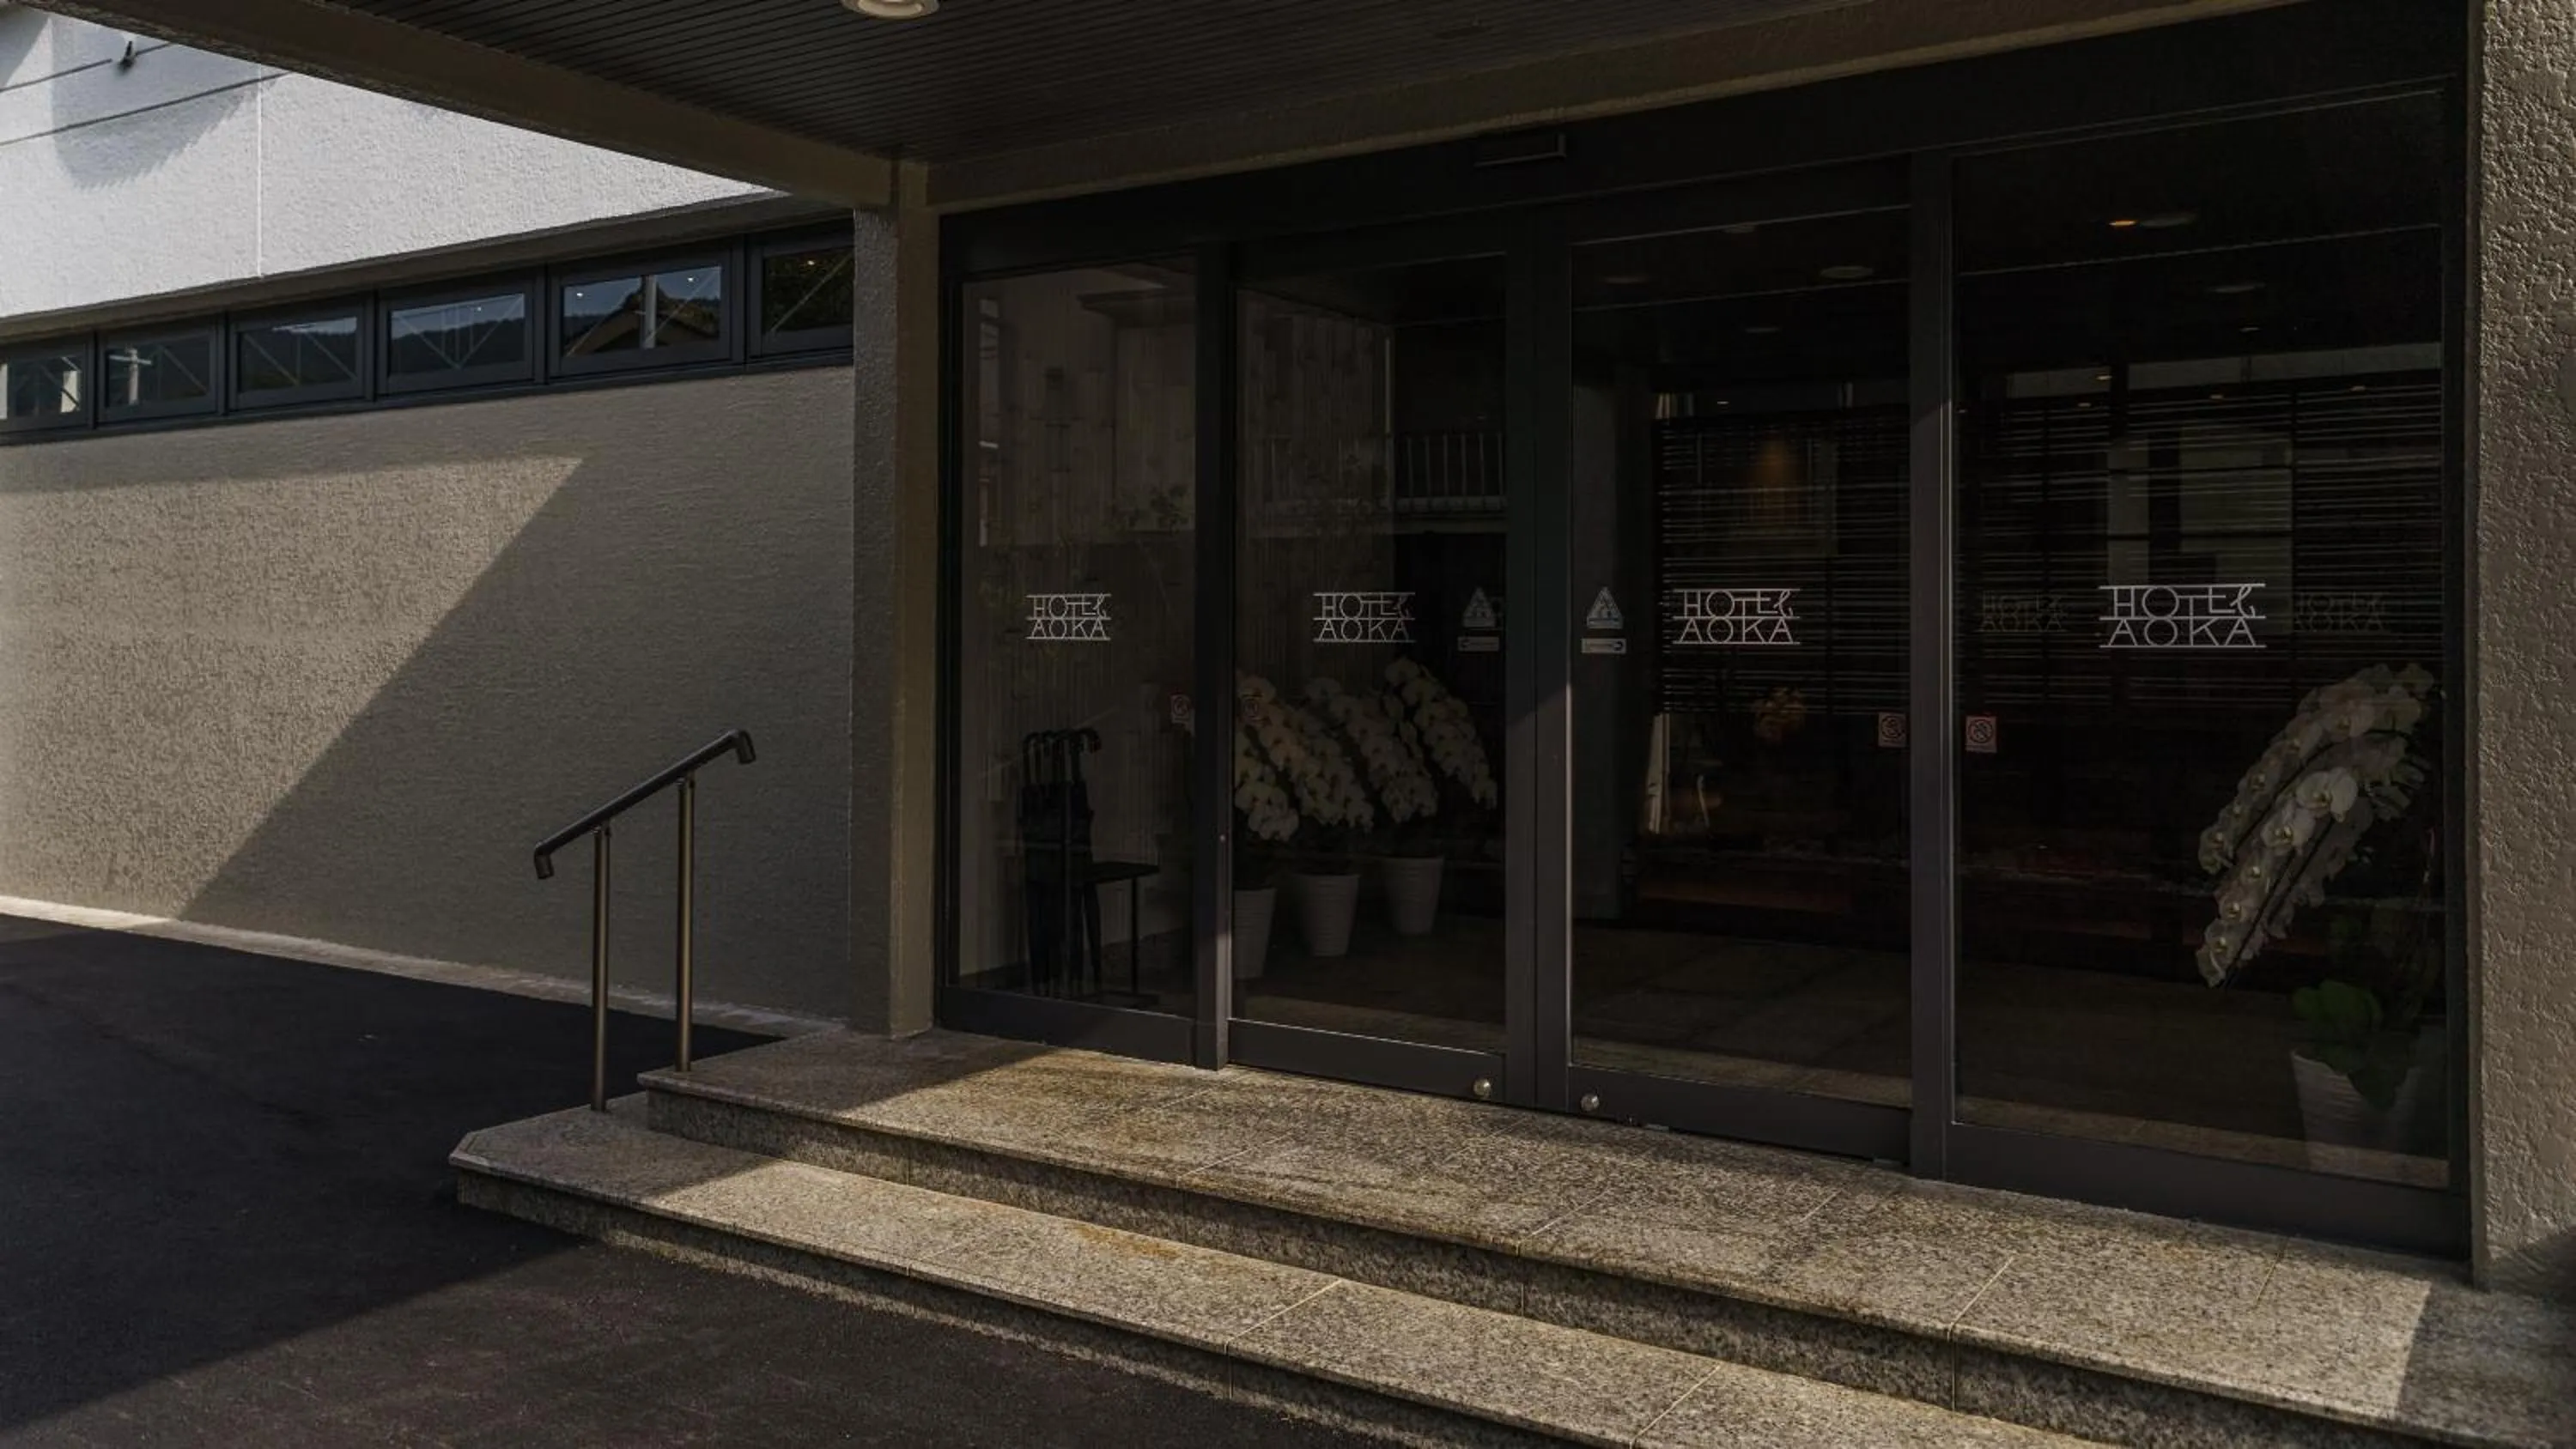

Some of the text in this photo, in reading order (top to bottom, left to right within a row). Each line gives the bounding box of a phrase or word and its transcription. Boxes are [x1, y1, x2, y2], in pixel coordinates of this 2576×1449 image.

[1033, 592, 1106, 620] HOTEL
[1321, 592, 1412, 620] HOTEL
[1684, 589, 1794, 619] HOTEL
[2113, 585, 2257, 621] HOTEL
[1031, 618, 1106, 640] AOKA
[1318, 618, 1410, 642] AOKA
[1680, 617, 1794, 645] AOKA
[2108, 618, 2257, 648] AOKA
